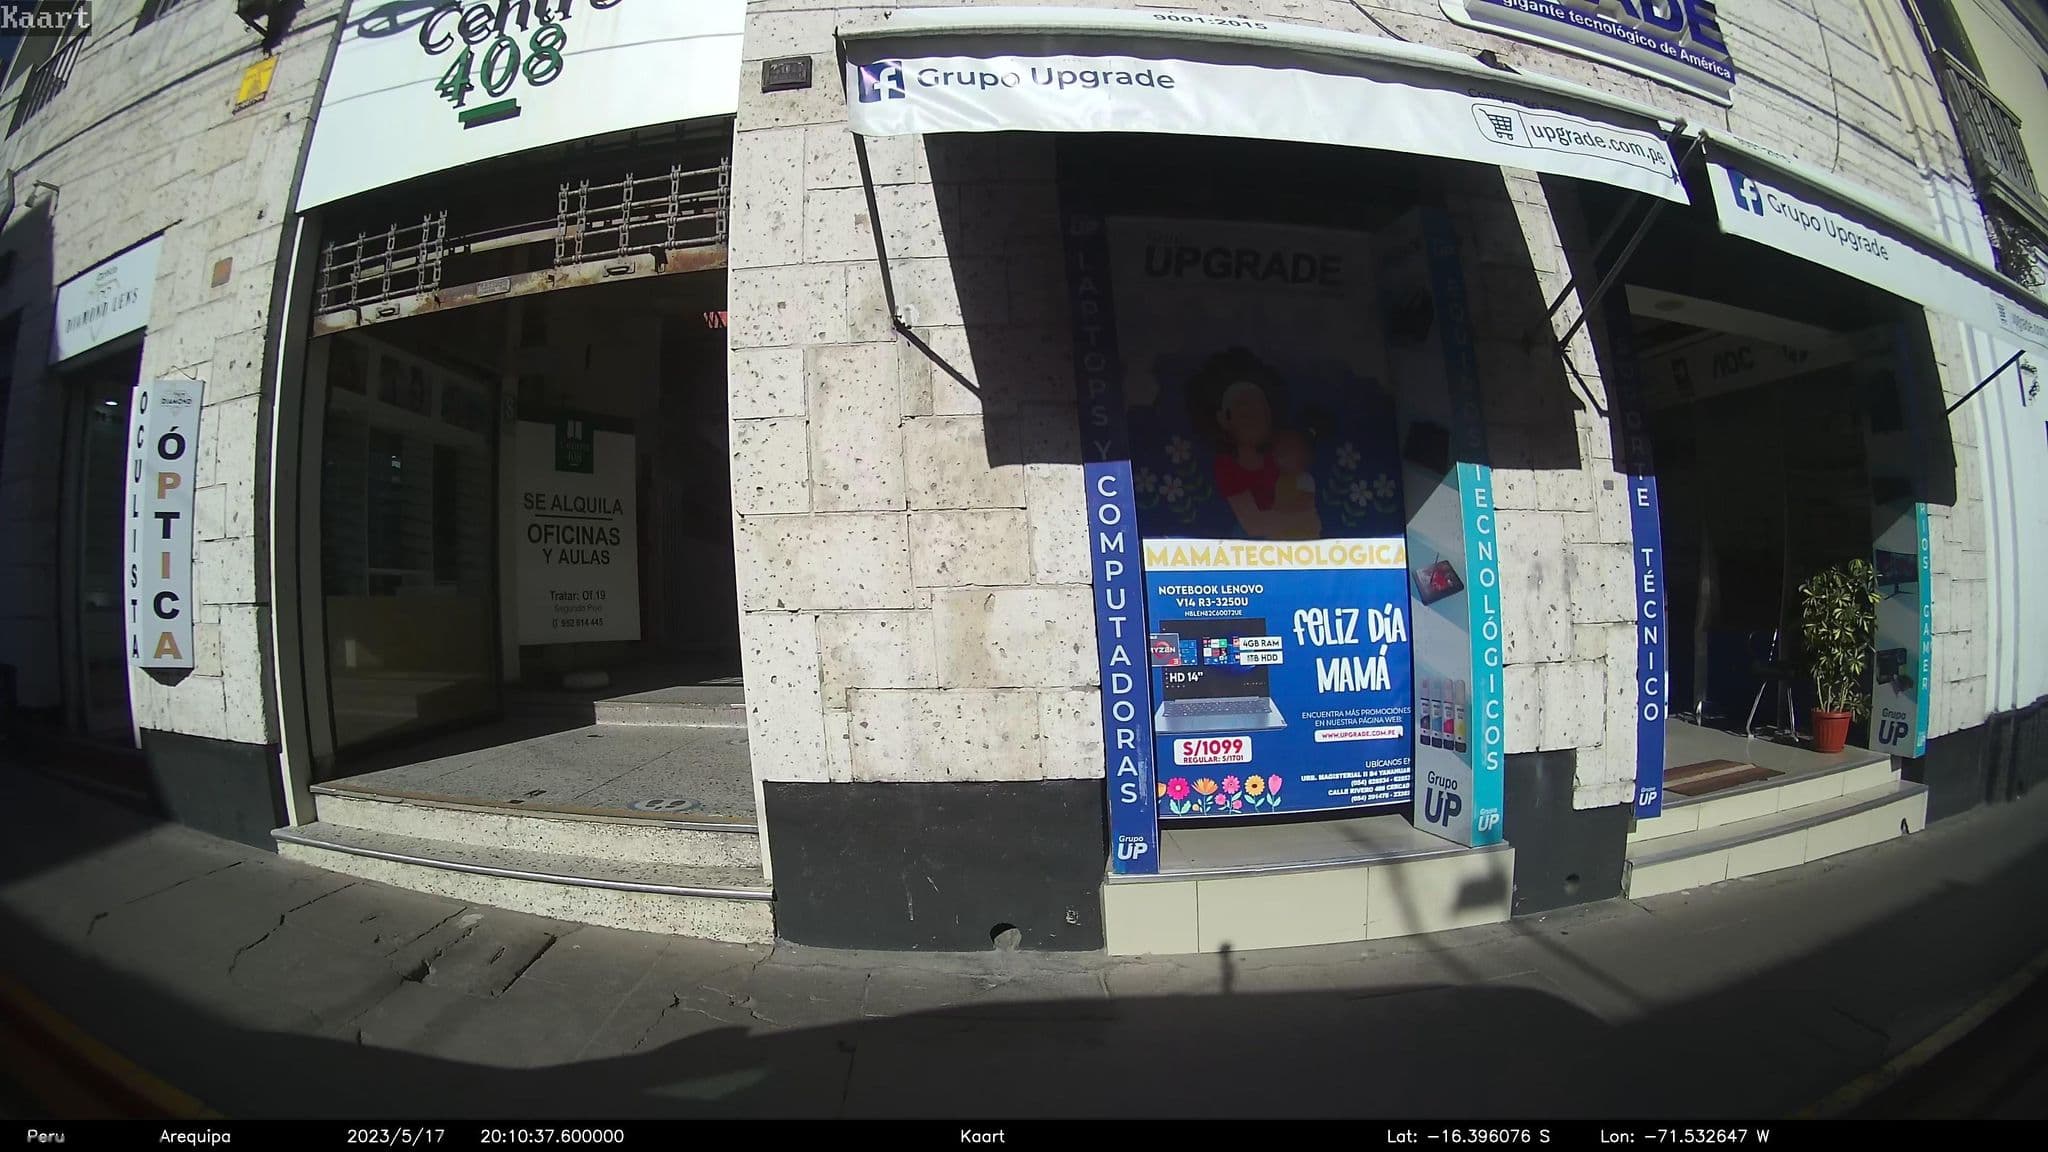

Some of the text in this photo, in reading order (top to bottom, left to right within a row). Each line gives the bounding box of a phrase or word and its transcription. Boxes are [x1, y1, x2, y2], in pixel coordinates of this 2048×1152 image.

[1153, 14, 1268, 30] 9001:2015
[1569, 9, 1657, 50] tecnológico
[1660, 40, 1678, 57] de
[1681, 49, 1731, 79] América
[434, 23, 568, 108] 408
[917, 66, 1175, 91] Grupo Upgrade
[1530, 123, 1667, 166] upgrade.com.pe
[1767, 194, 1890, 261] Grupo Upgrade
[1144, 245, 1343, 287] UPGRADE
[524, 492, 624, 515] SE ALQUILA
[131, 391, 148, 659] OCULISTA
[527, 523, 621, 546] OFICINAS
[153, 426, 186, 660] ÓPTICA
[542, 548, 611, 565] Y AULAS
[1158, 584, 1264, 596] NOTEBOOK LENOVO
[1176, 597, 1249, 608] V14 R3-3250U
[1097, 475, 1139, 803] COMPUTADORAS
[1243, 638, 1280, 648] 4GB RAM
[1641, 548, 1659, 721] TÉCNICO
[1261, 653, 1278, 662] HDD
[1169, 672, 1185, 683] HD
[1316, 644, 1392, 694] MAMÁ
[1301, 711, 1344, 719] ENCUENTRA
[1345, 709, 1360, 717] MÁS
[1361, 706, 1412, 716] PROMOCIONES
[1326, 718, 1357, 726] NUESTRA
[1358, 716, 1384, 726] PÁGINA
[1321, 728, 1396, 739] WWW.UPGRADE.COM.PE
[1879, 720, 1909, 746] UP
[1183, 739, 1243, 757] S/1099
[1183, 754, 1244, 764] REGULAR: S/1701
[1365, 758, 1402, 769] UBÍCANOS
[1427, 770, 1458, 791] Grupo
[1424, 786, 1463, 828] UP
[1638, 791, 1658, 806] UP
[1478, 813, 1500, 832] UP
[1118, 835, 1145, 844] Grupo
[1117, 843, 1148, 860] UP
